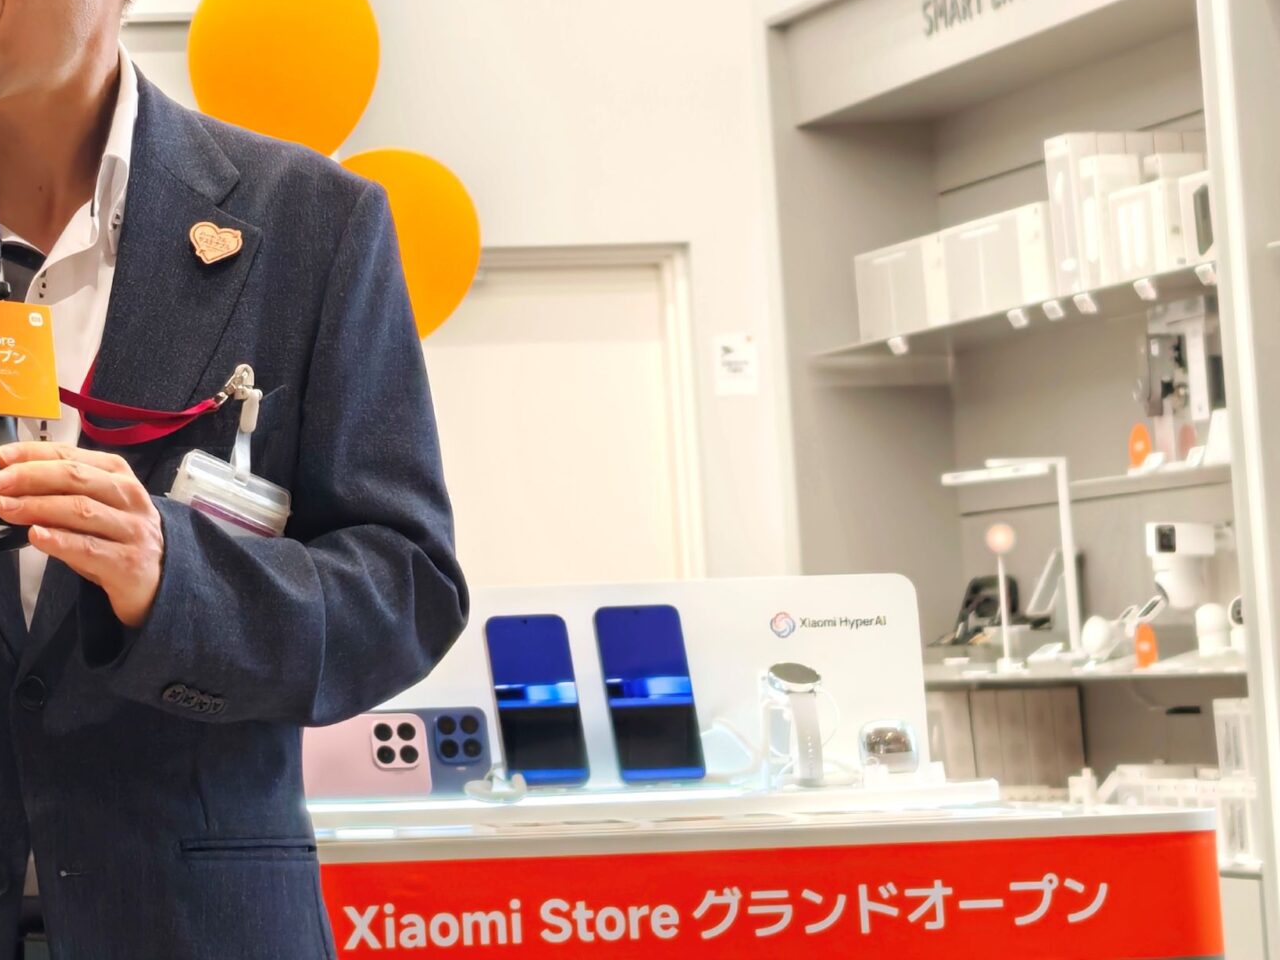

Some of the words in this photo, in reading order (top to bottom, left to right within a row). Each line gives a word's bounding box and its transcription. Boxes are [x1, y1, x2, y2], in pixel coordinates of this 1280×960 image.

[800, 616, 838, 629] Xiaomi
[342, 897, 522, 951] Xiaomi
[539, 897, 680, 943] Store
[692, 872, 1109, 940] グランドオープン
